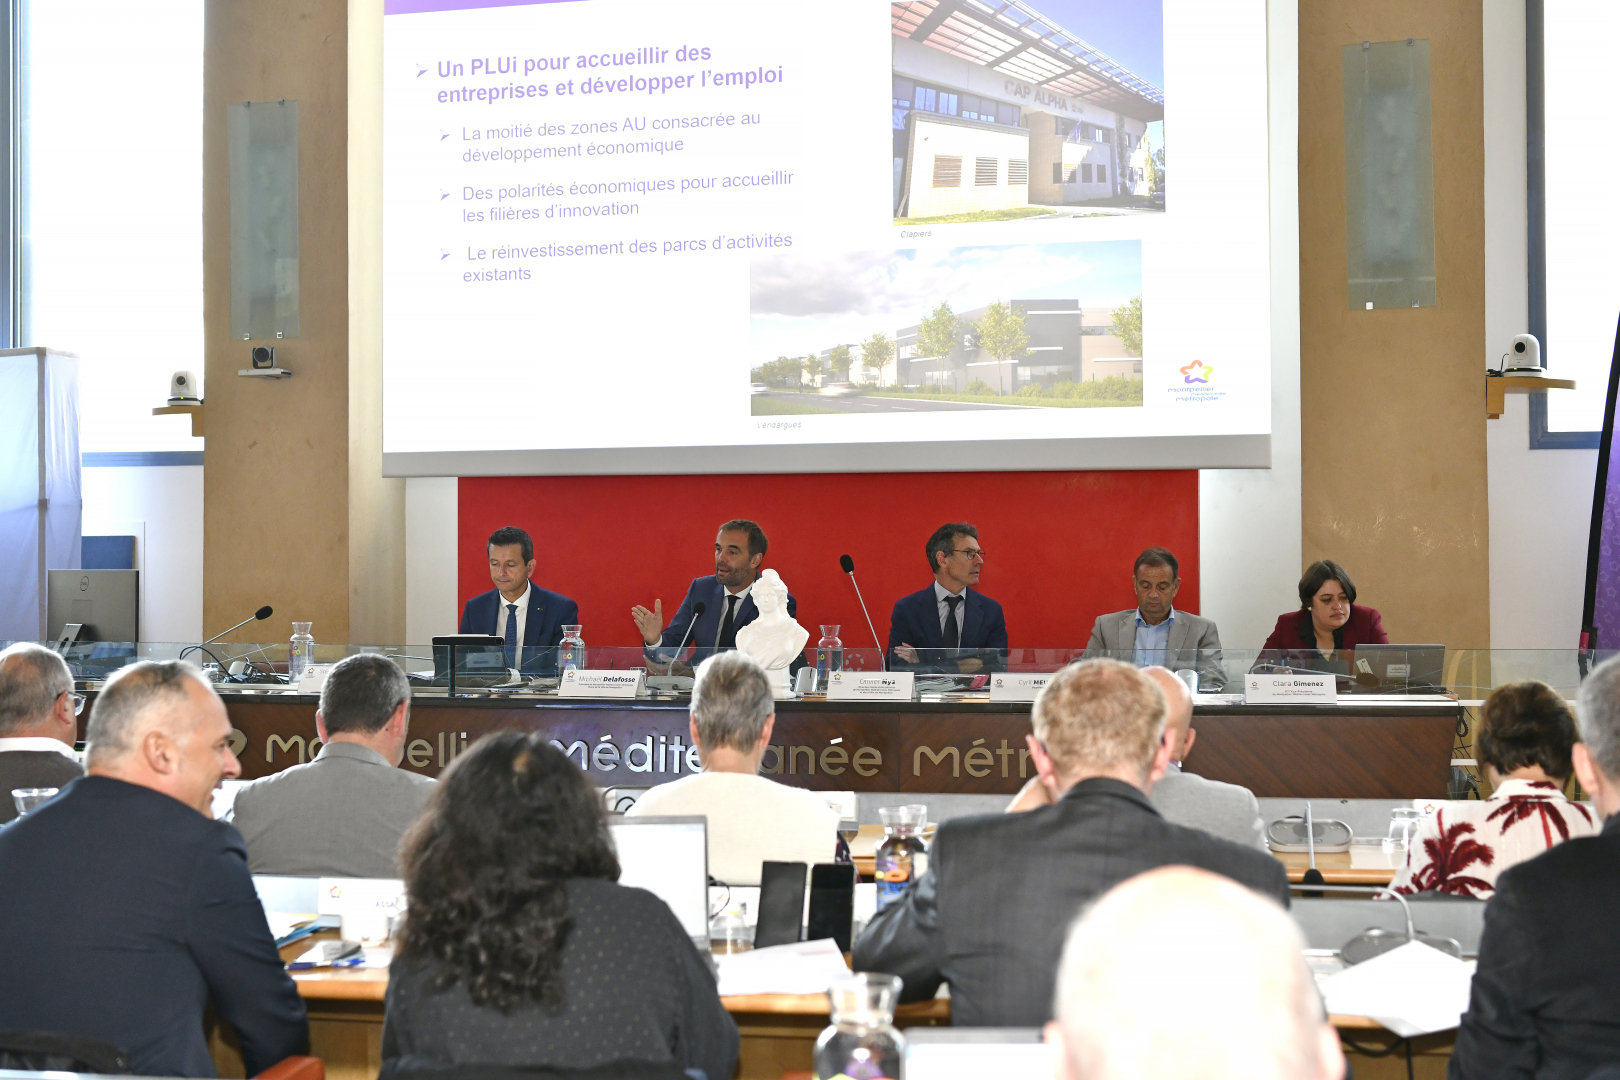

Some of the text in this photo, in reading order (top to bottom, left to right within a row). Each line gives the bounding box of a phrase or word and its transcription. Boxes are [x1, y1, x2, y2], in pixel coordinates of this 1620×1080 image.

[438, 44, 712, 78] Un PLUi pour accueillir des
[437, 82, 549, 105] entreprises
[555, 79, 575, 96] et
[580, 74, 695, 95] développer
[1004, 79, 1068, 111] CAP ALPHA
[462, 112, 761, 141] La moitié des zones AU consacrée au
[462, 137, 684, 164] développement économique
[463, 170, 795, 202] Des polarités économiques pour accueillir
[463, 208, 485, 223] les
[489, 206, 540, 221] filières
[900, 230, 932, 239] Clapiers
[467, 246, 487, 261] Le
[492, 240, 624, 260] réinvestissement
[628, 238, 658, 254] des
[663, 239, 707, 256] parcs
[462, 266, 532, 283] existants
[756, 421, 801, 430] Vendargues
